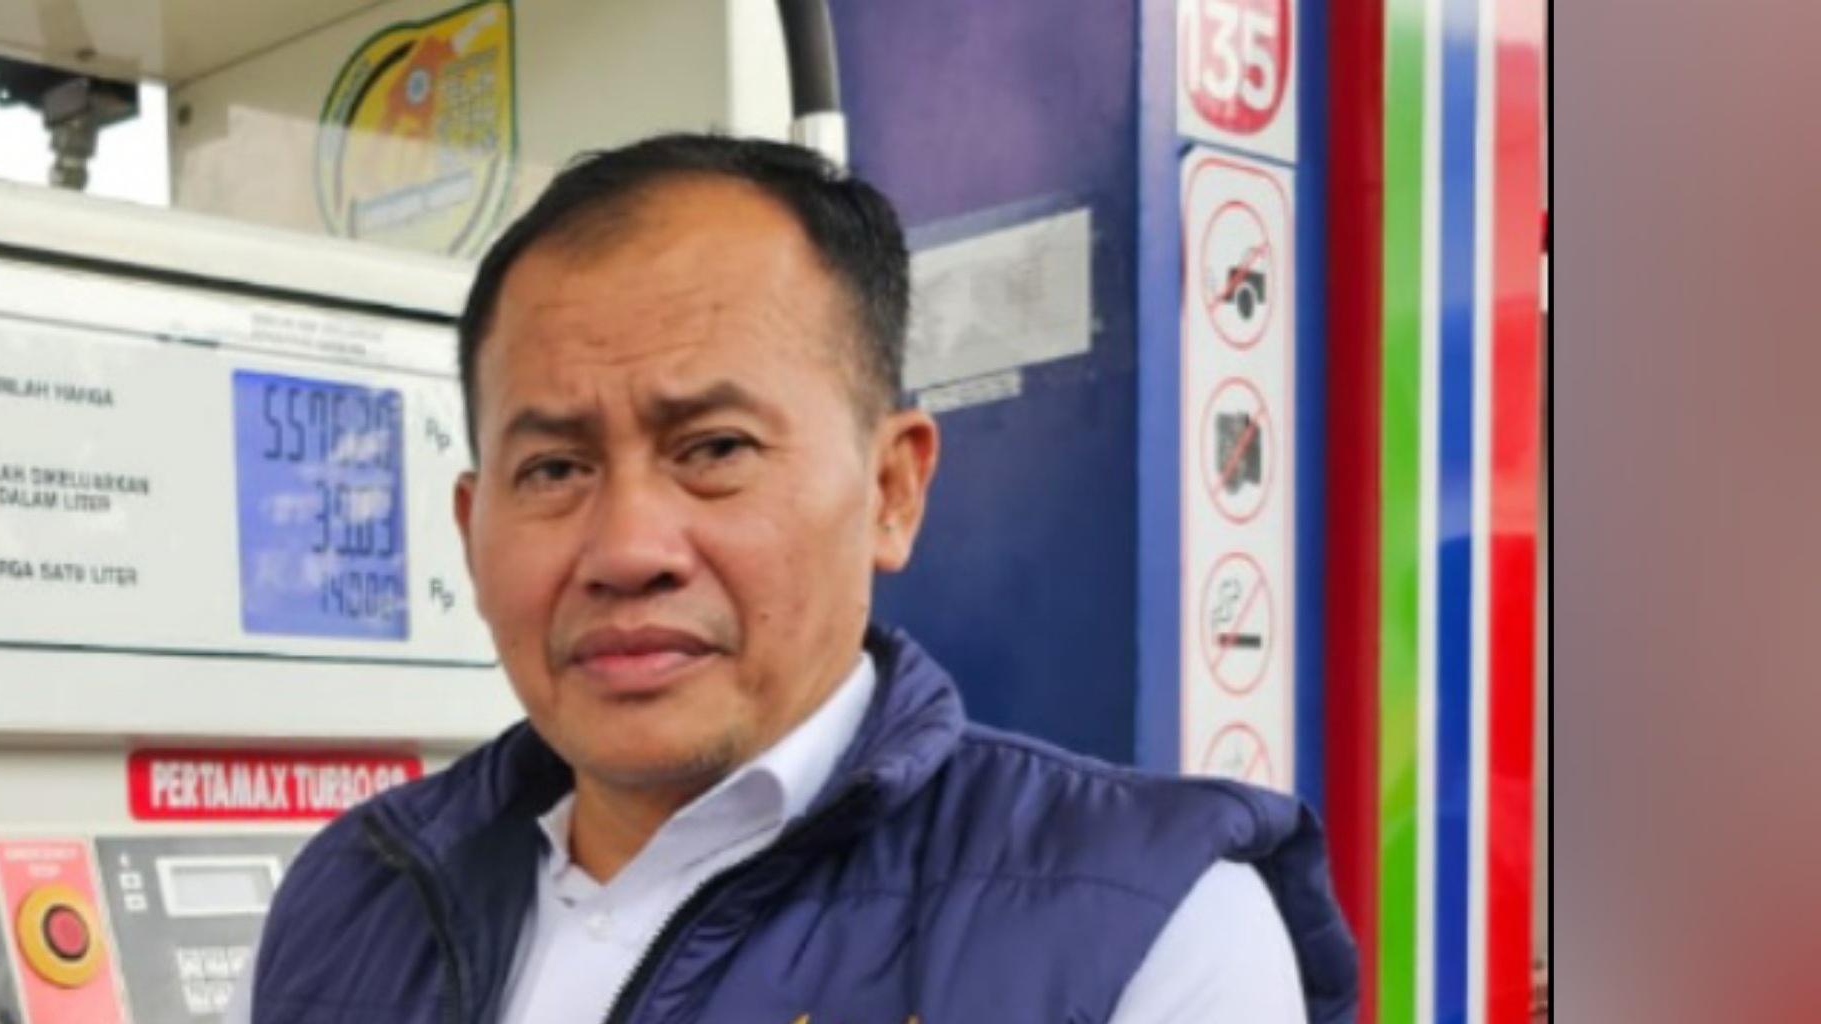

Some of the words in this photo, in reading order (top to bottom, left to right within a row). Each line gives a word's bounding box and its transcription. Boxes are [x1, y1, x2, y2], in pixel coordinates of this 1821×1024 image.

[1188, 0, 1275, 109] 135
[54, 382, 113, 406] HARGA
[30, 467, 150, 497] DIKELUARKAN
[63, 493, 111, 513] LITER
[39, 562, 85, 584] SATU
[90, 565, 138, 587] LITER
[150, 760, 288, 810] PERTAMAX
[293, 763, 372, 810] TURBO
